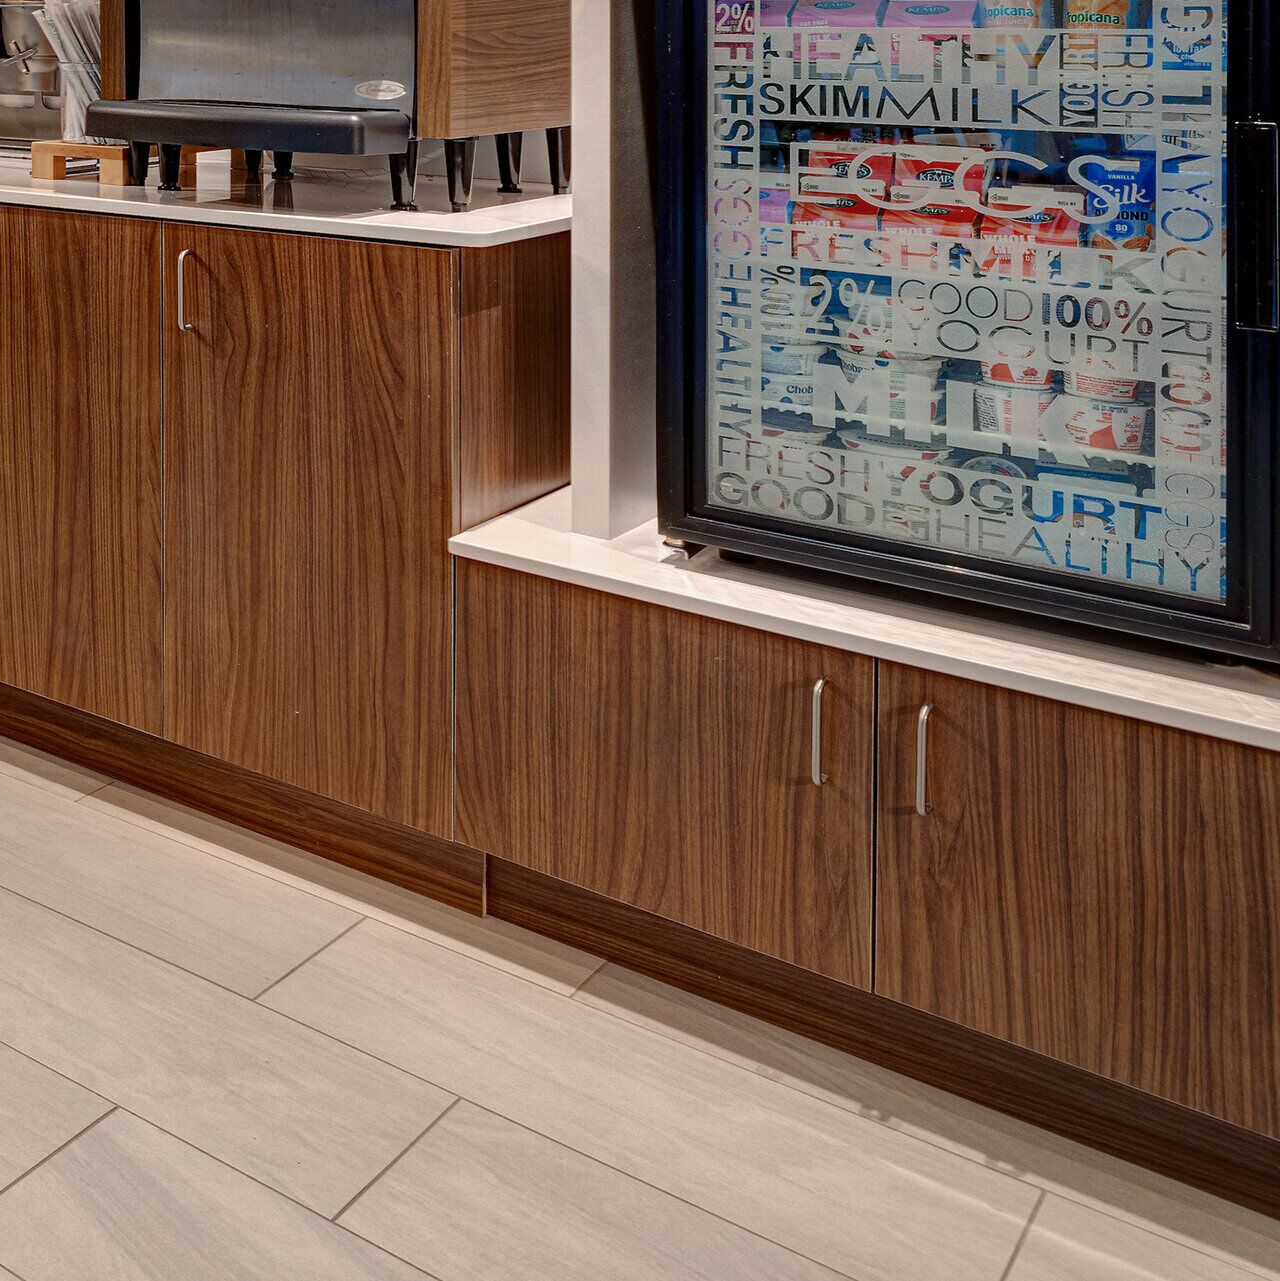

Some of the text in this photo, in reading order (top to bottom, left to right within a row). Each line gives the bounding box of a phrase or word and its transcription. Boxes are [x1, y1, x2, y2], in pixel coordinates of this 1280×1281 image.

[715, 2, 755, 34] 2%
[762, 32, 1057, 86] HEALTHY
[1060, 34, 1098, 127] YOGURT
[713, 41, 755, 171] FRESH
[789, 141, 1121, 225] EGGS
[1093, 183, 1150, 208] Silk
[1107, 173, 1136, 181] VANILLA
[884, 226, 934, 236] WHOLE
[984, 233, 1037, 245] WHOLE
[1115, 223, 1128, 232] 80
[760, 226, 938, 271] FRESH
[948, 241, 1157, 296] MILK
[801, 274, 887, 336] 2%
[898, 279, 1034, 322] GOOD
[1041, 291, 1154, 337] 100%
[715, 283, 753, 441] HEALTHY
[904, 316, 1150, 374] YOGURT
[786, 384, 814, 394] Chob
[718, 435, 870, 493] FRESH
[715, 471, 876, 527] GOOD
[879, 459, 1163, 541] YOGURT
[936, 507, 1210, 593] HEALTHY
